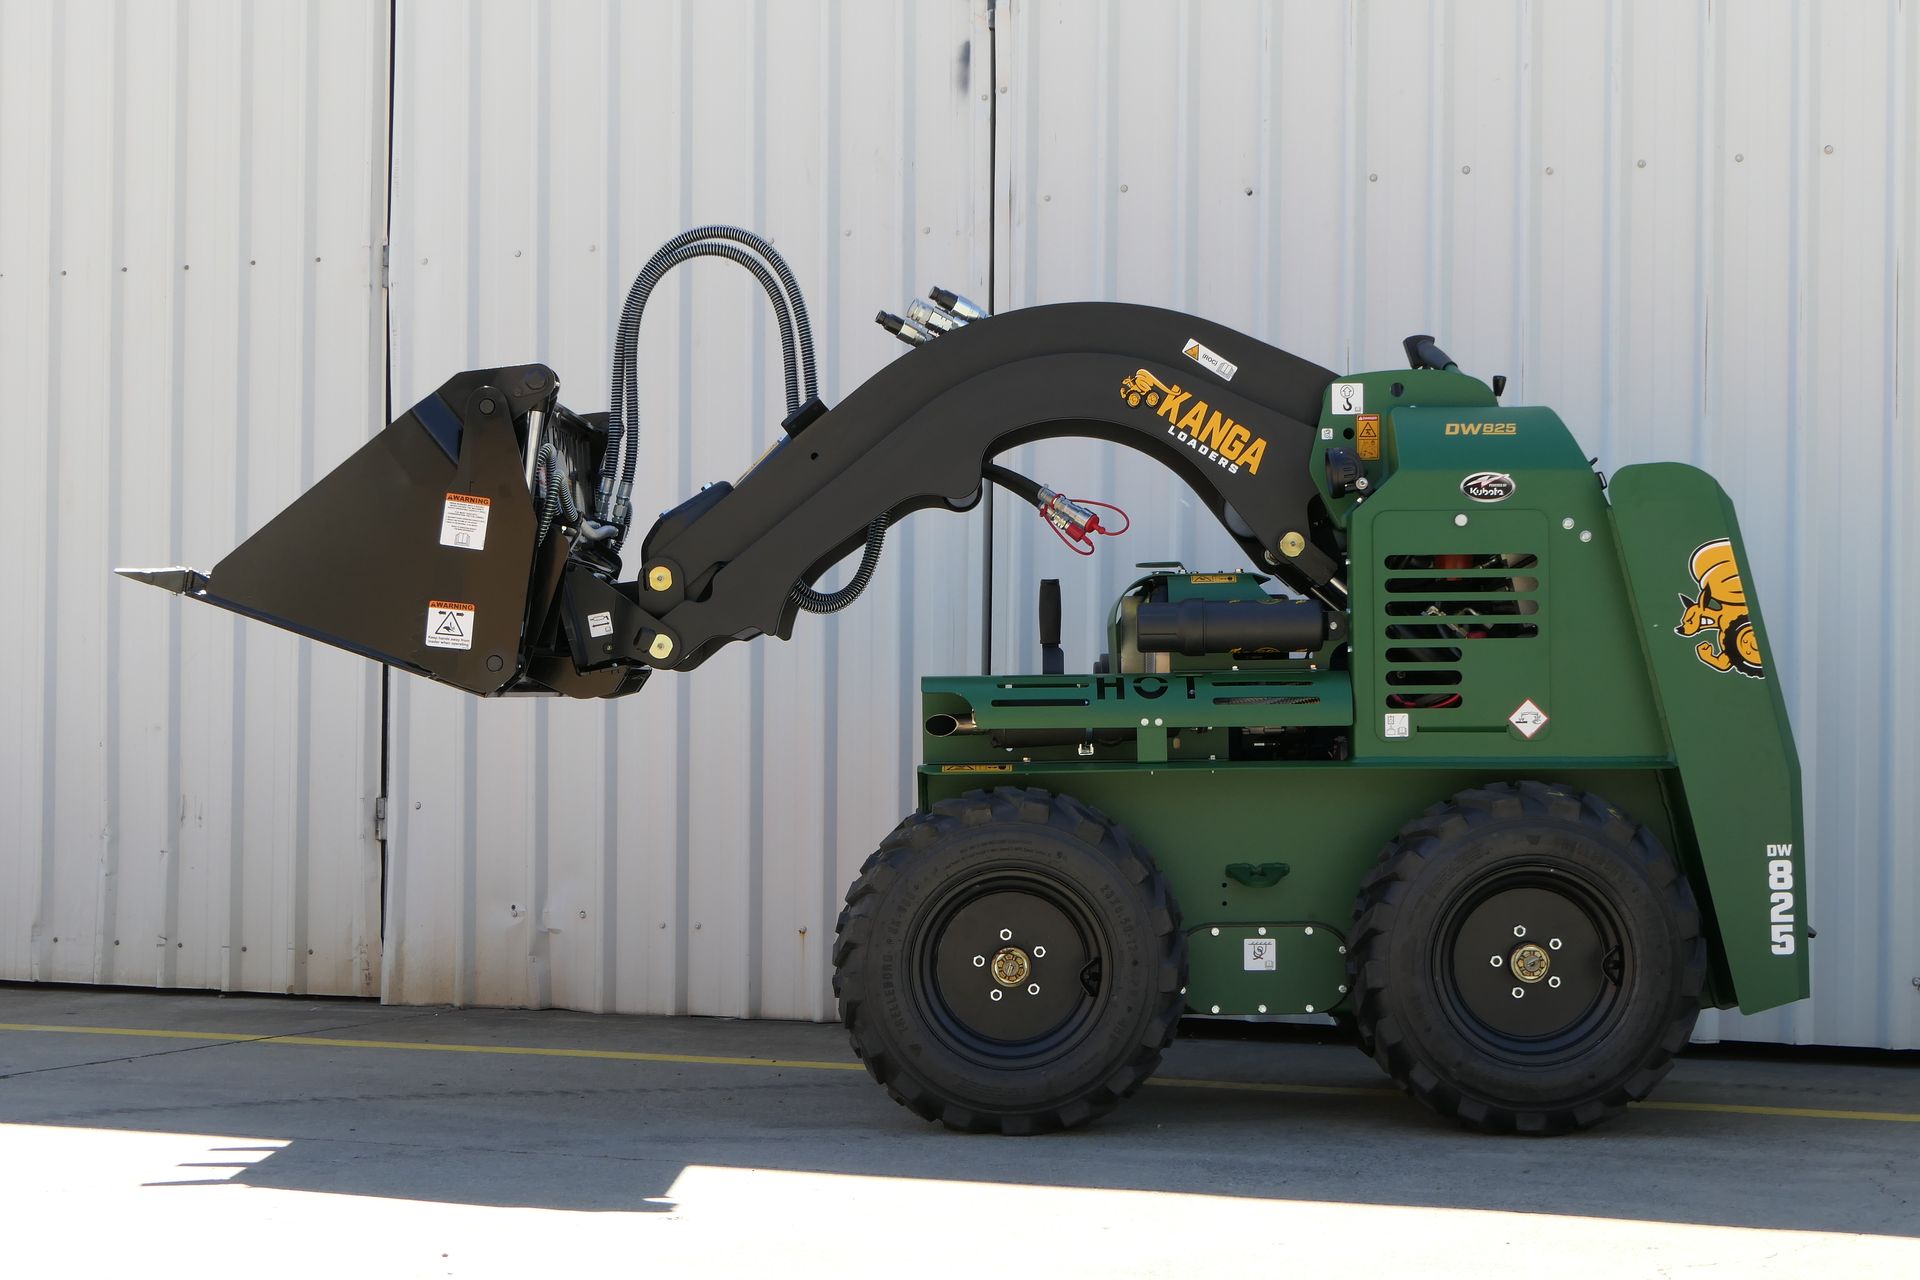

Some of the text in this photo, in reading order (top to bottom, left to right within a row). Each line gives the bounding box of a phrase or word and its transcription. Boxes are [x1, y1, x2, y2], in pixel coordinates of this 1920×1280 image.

[1156, 385, 1268, 476] KANGA
[1445, 423, 1517, 435] DW825
[1168, 425, 1240, 475] LOADERS
[1469, 487, 1504, 496] Kubota
[454, 494, 489, 505] WARNING
[437, 602, 473, 610] WARNING
[1096, 675, 1203, 699] HOT
[1766, 844, 1792, 857] DW
[1768, 860, 1795, 955] 825
